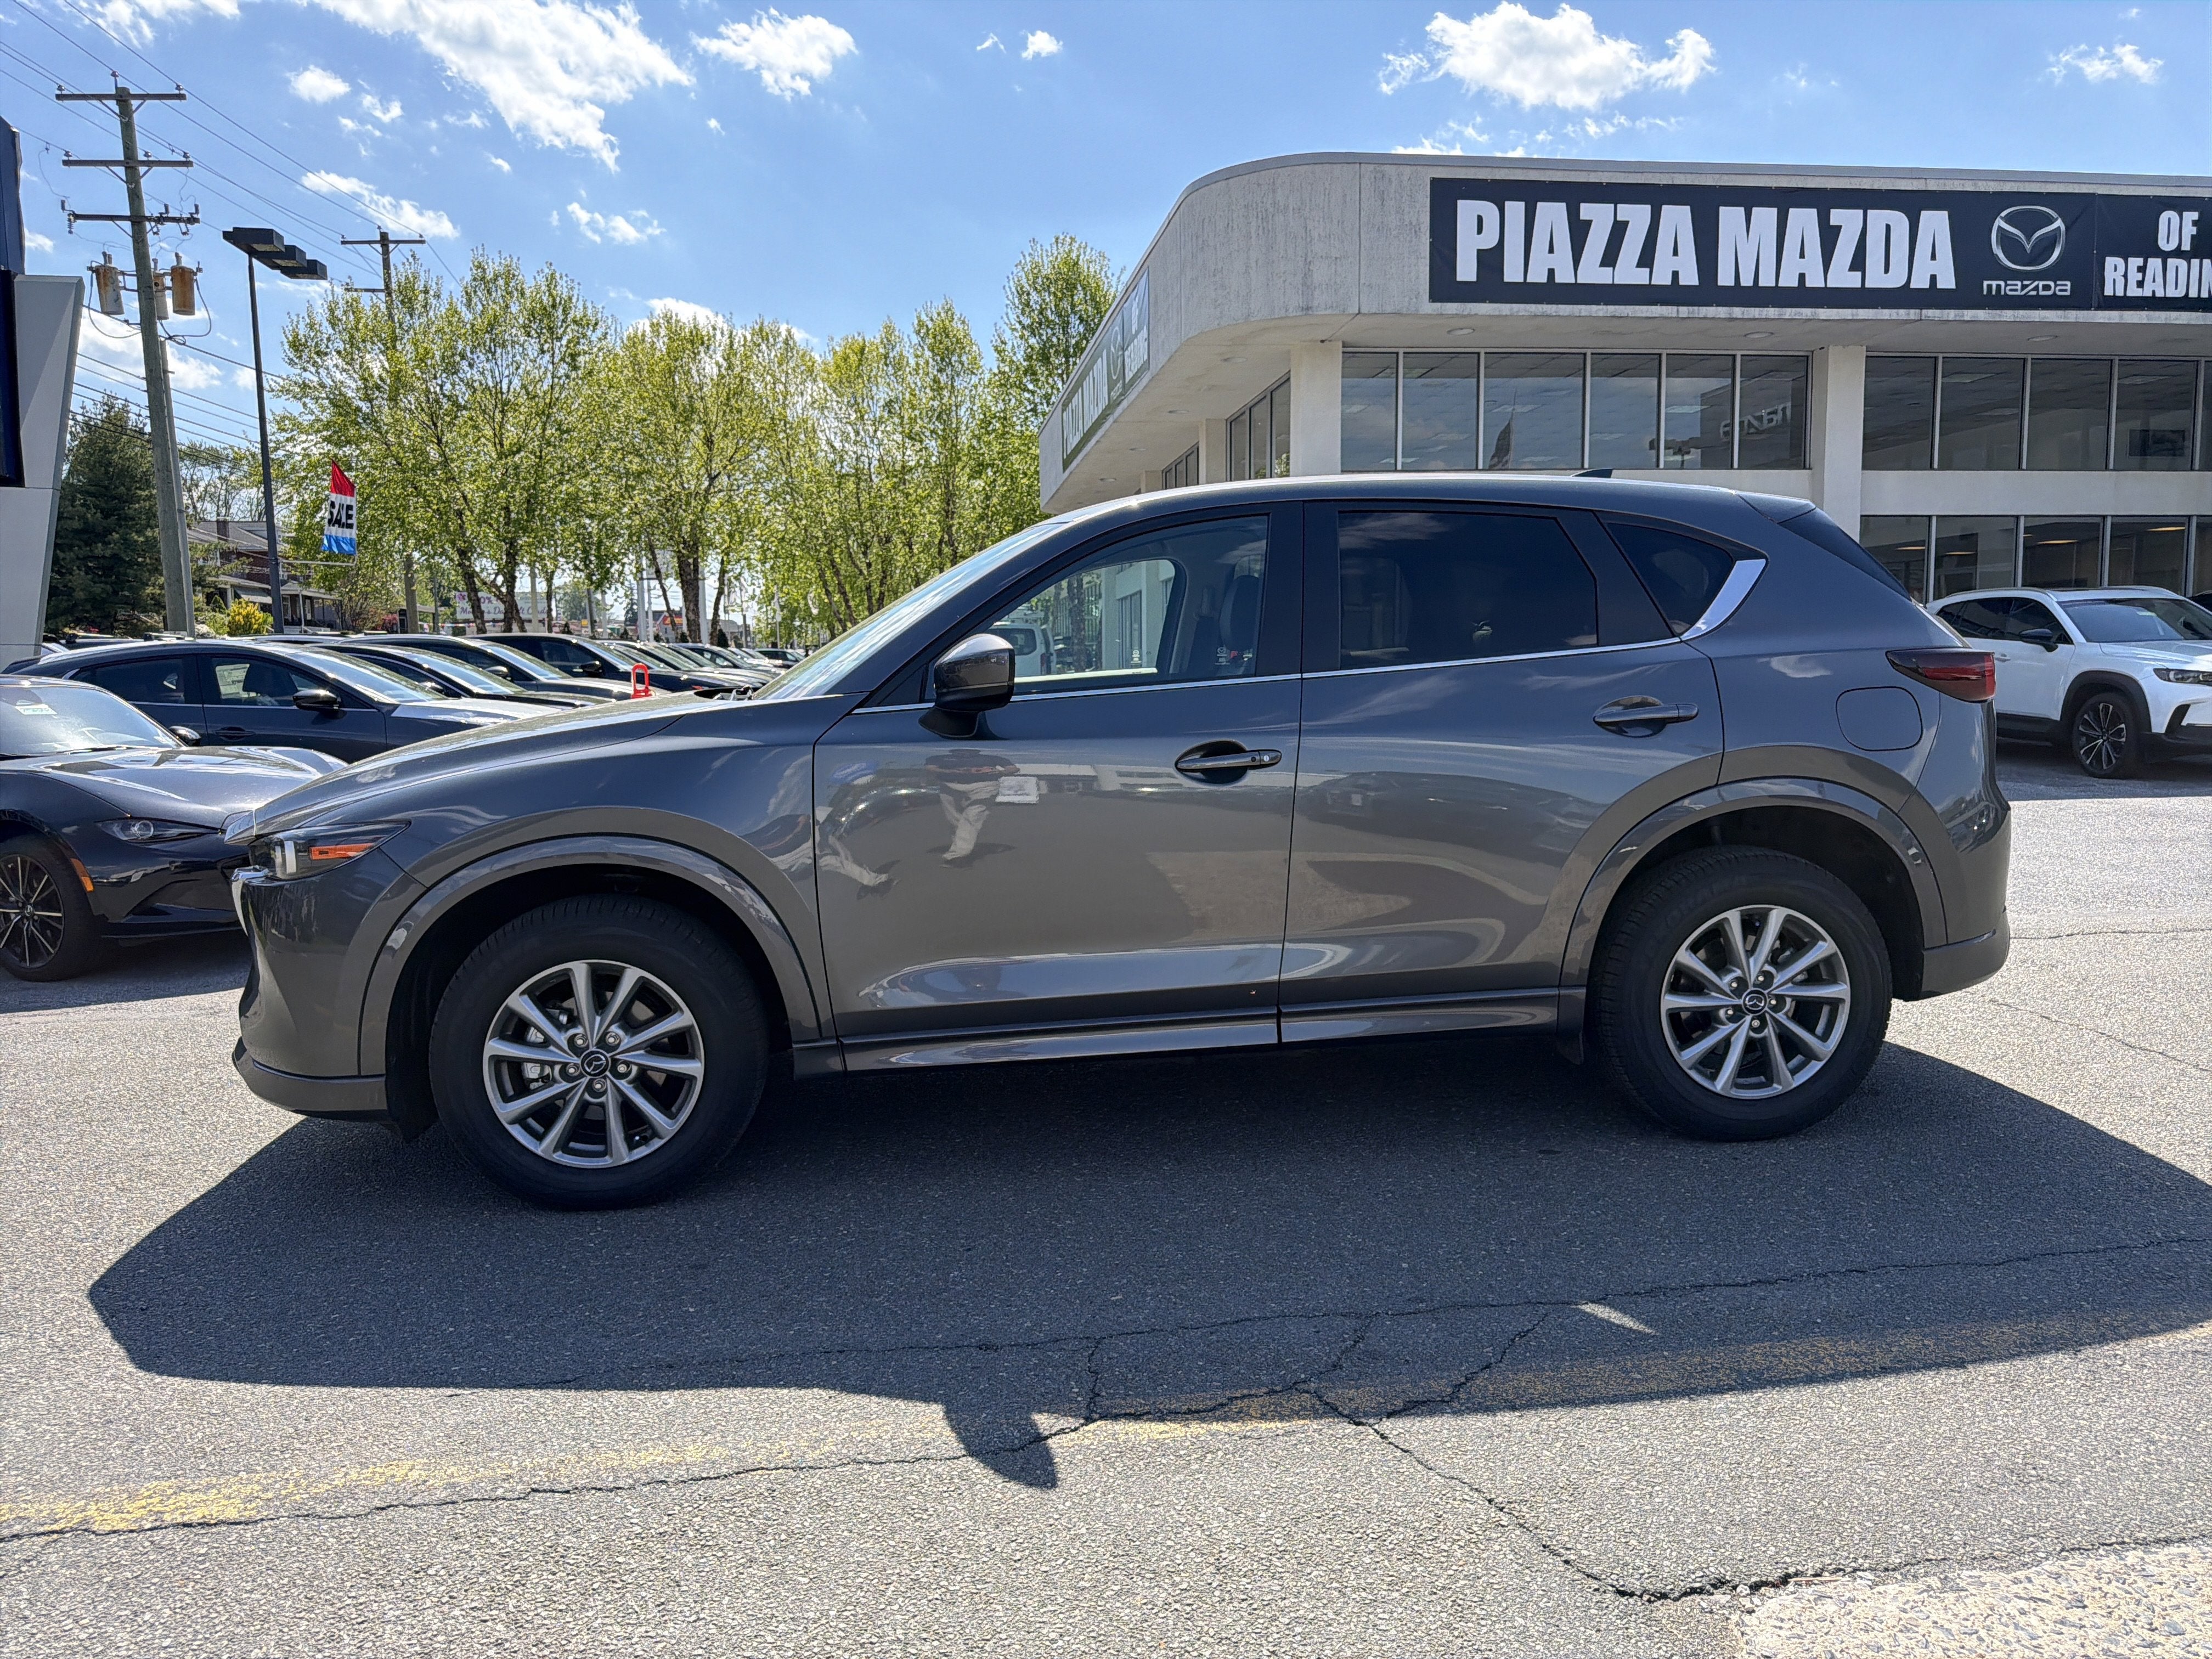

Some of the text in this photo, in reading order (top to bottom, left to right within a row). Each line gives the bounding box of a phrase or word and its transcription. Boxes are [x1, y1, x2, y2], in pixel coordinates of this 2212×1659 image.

[1456, 199, 1956, 289] PIAZZA MAZDA
[2158, 210, 2199, 251] OF
[1084, 348, 1108, 433] MAZDA
[328, 500, 354, 529] SALE
